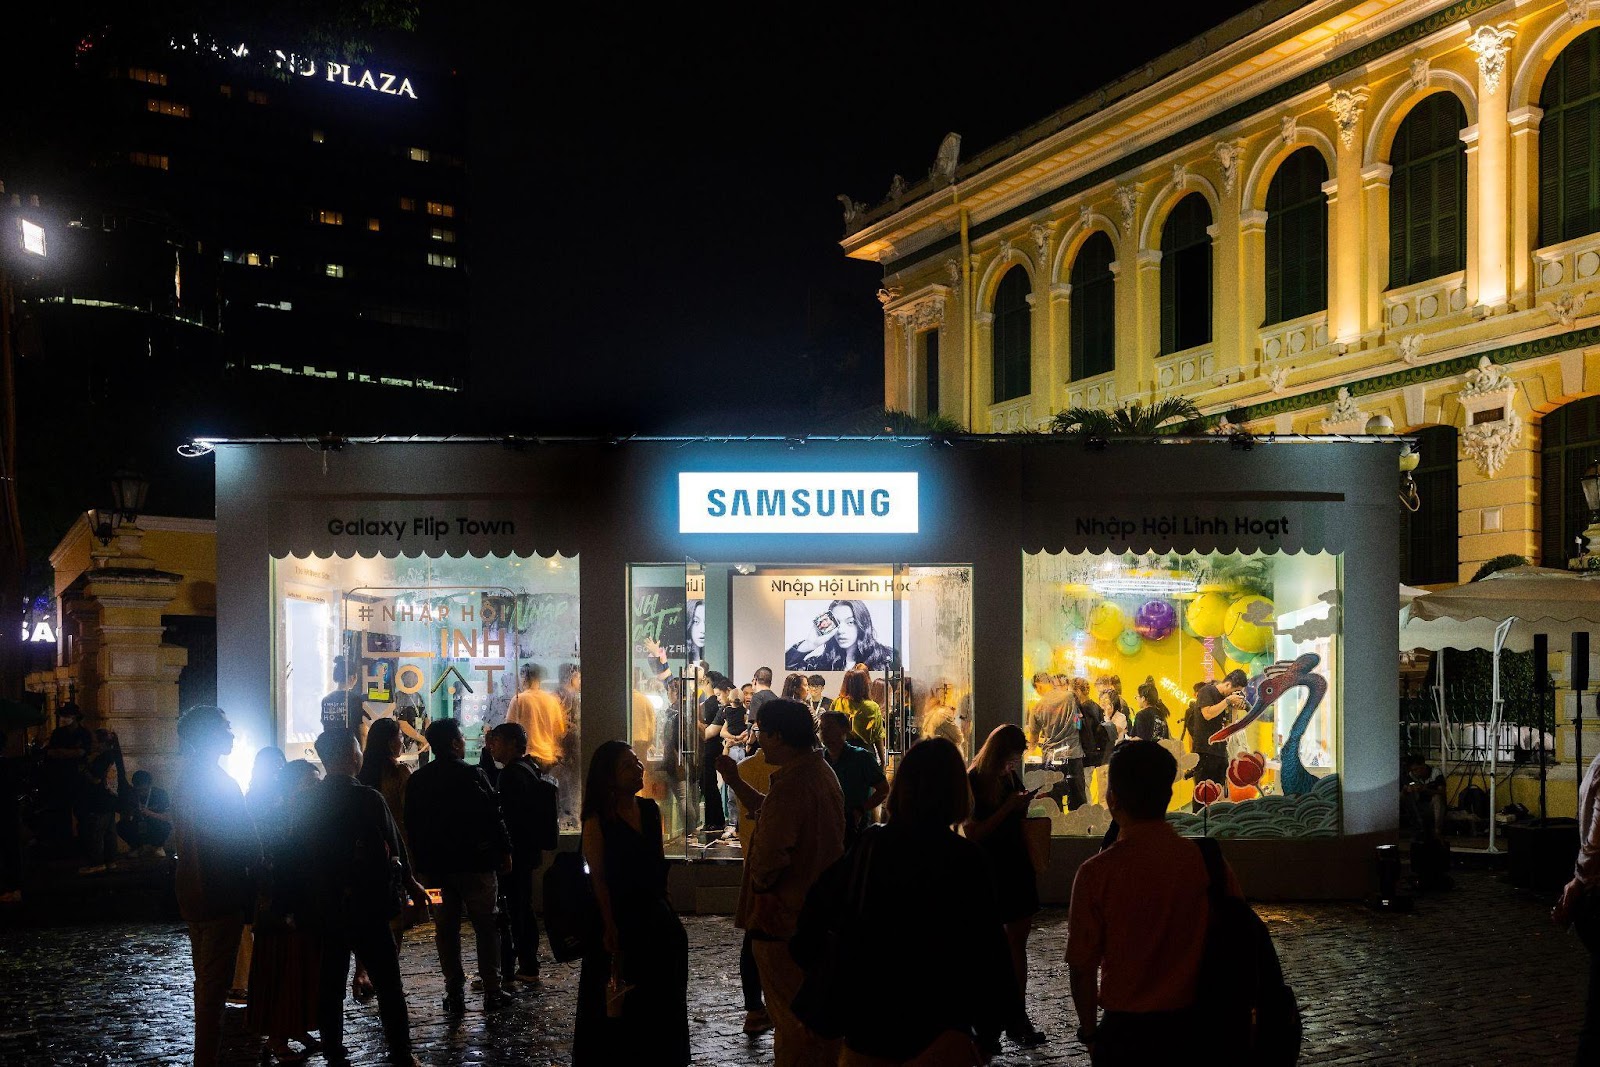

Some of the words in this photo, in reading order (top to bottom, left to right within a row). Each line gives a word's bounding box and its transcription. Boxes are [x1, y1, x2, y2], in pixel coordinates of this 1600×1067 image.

[326, 61, 418, 99] PLAZA
[707, 488, 890, 517] SAMSUNG
[327, 517, 406, 541] Galaxy
[413, 517, 449, 541] Flip
[456, 517, 515, 536] Town
[1076, 516, 1136, 541] Nhập
[1142, 516, 1177, 540] Hội
[1184, 515, 1228, 535] Linh
[1235, 516, 1289, 541] Hoạt
[772, 579, 814, 596] Nhập
[819, 579, 843, 596] Hội
[848, 579, 880, 592] Linh
[361, 664, 506, 695] HOẠT
